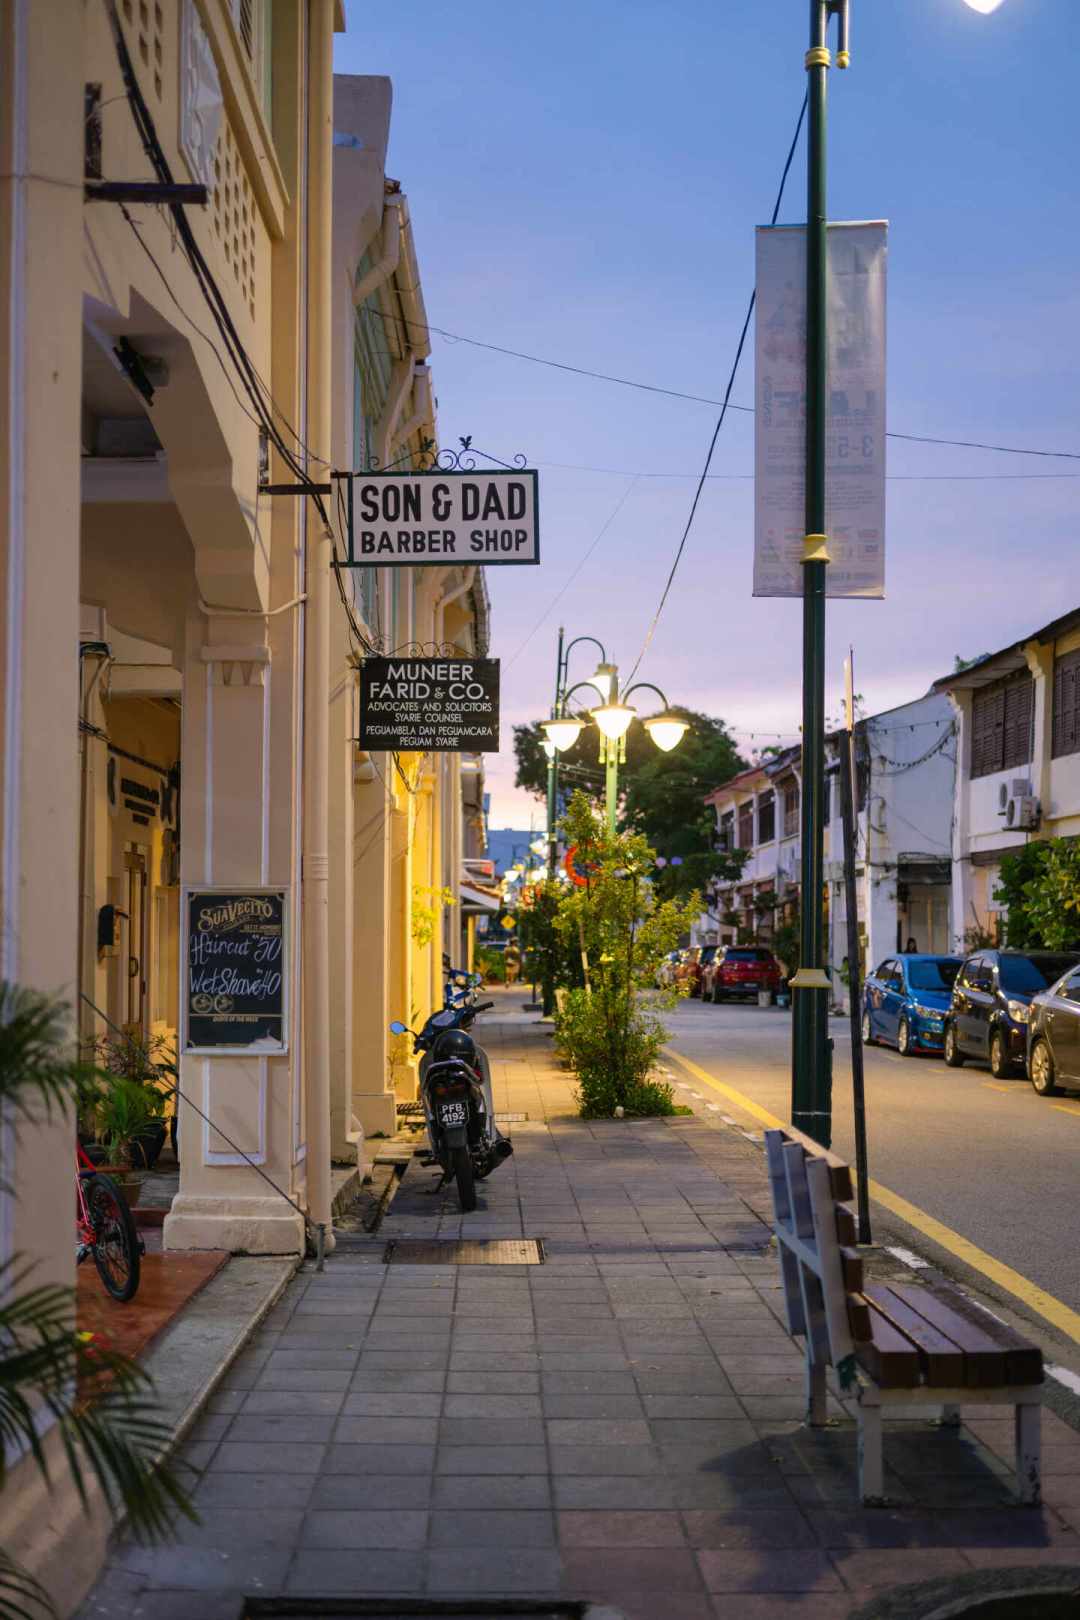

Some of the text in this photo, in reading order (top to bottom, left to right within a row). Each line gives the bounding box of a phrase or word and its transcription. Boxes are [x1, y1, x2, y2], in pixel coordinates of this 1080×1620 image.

[360, 482, 526, 522] SON & DAD
[361, 529, 528, 554] BARBER SHOP
[387, 664, 474, 681] MUNEER
[370, 682, 490, 700] FARID & CO.
[367, 702, 493, 712] ADVOCATES AND SOLICITORS
[394, 713, 464, 723] SYARIE COUNSEL
[366, 725, 493, 736] PEGUAMBELA DAN PEGUAMCARA
[399, 737, 460, 746] PEGUAM SYARIE
[191, 932, 250, 965] Haircut
[190, 967, 220, 994] Wet
[219, 967, 262, 996] Shave
[441, 1103, 463, 1114] PFB
[441, 1111, 465, 1122] 4192
